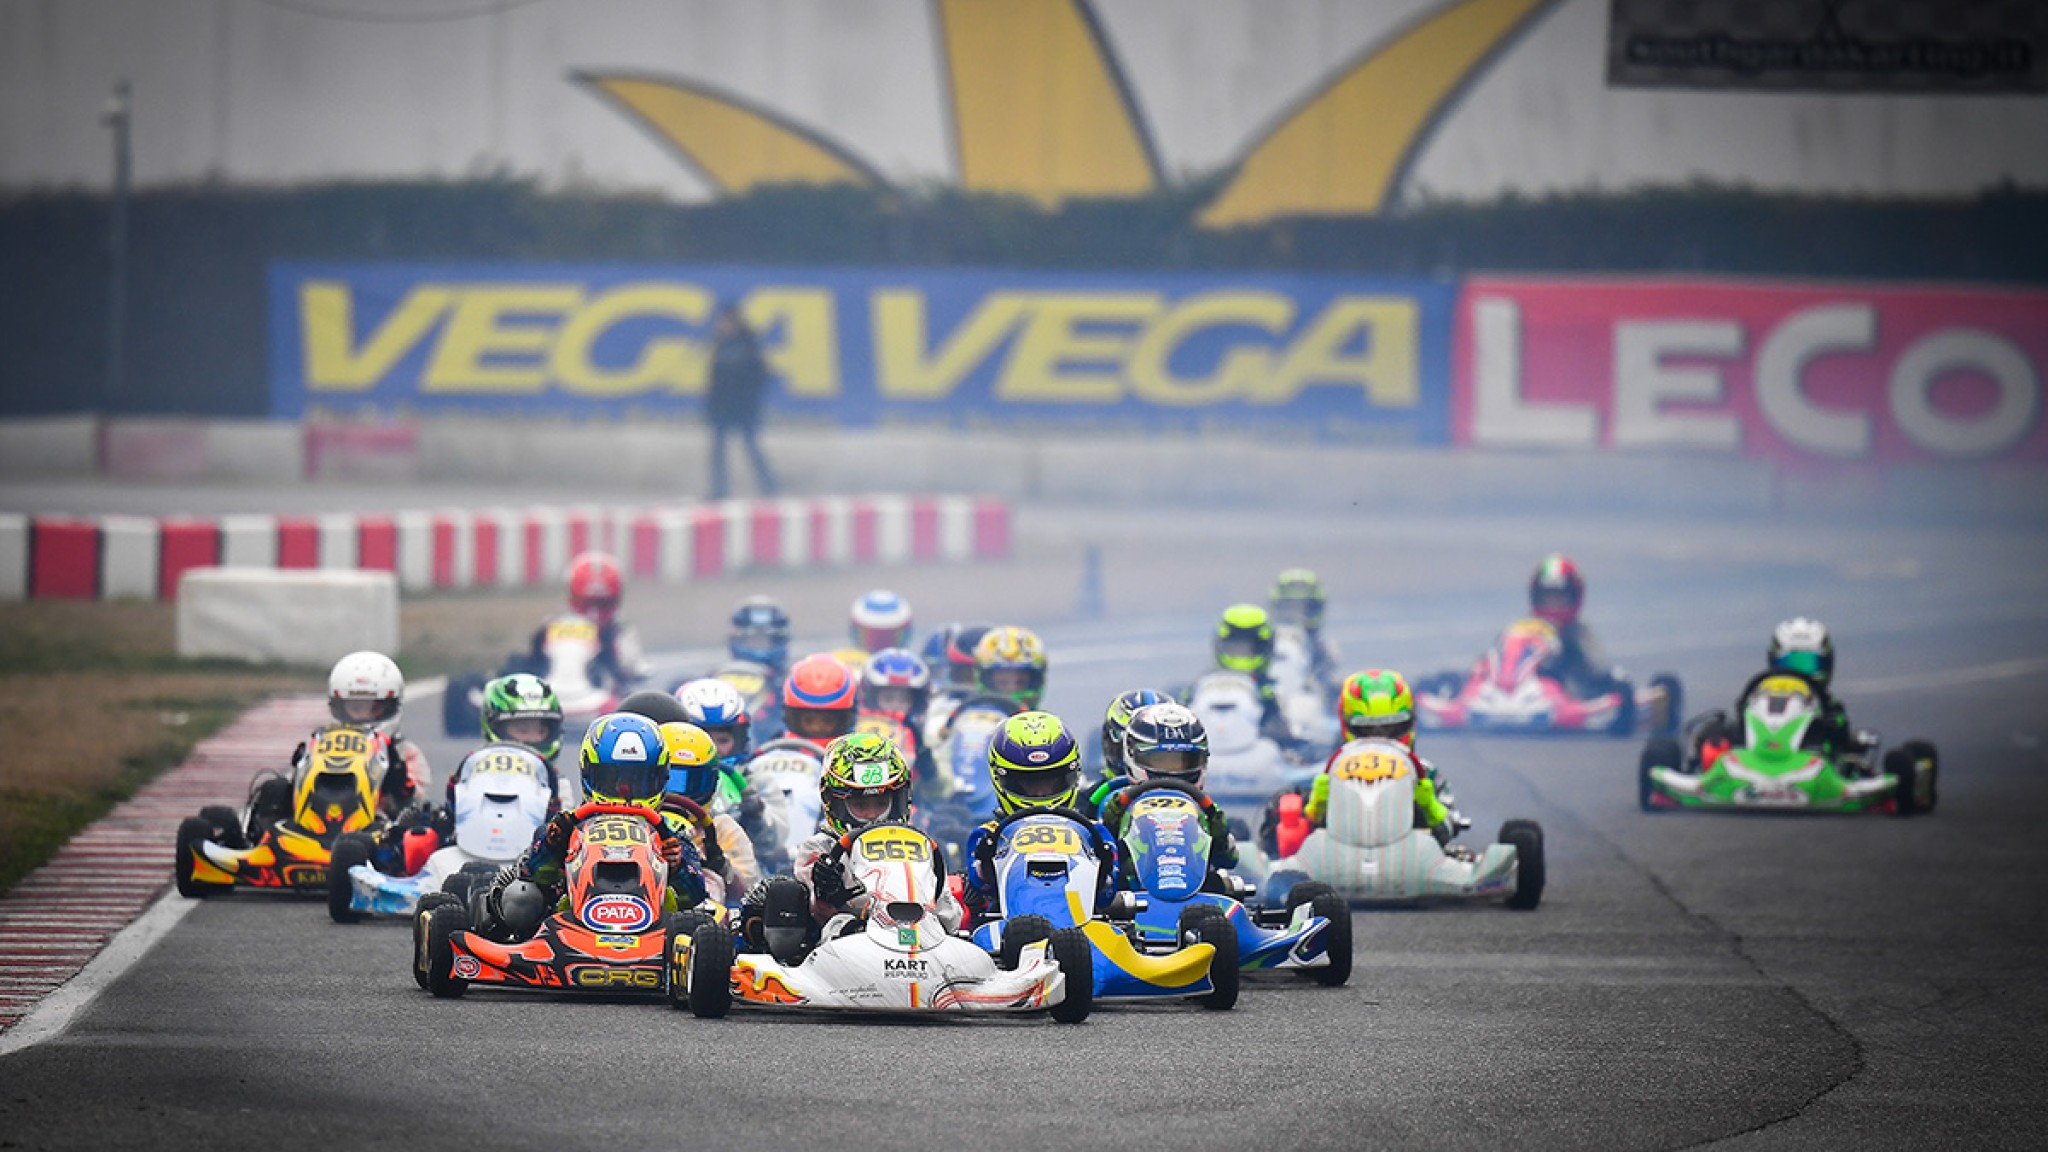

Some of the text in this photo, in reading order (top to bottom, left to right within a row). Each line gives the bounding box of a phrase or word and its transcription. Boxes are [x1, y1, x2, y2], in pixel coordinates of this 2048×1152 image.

[301, 280, 840, 396] VEGA
[870, 287, 1420, 406] VEGA
[318, 733, 367, 754] 596
[475, 755, 532, 777] 593
[1345, 754, 1397, 775] 631
[588, 822, 648, 844] 550
[1016, 826, 1073, 847] 587
[866, 840, 925, 862] 563
[596, 906, 638, 919] PATA
[884, 959, 927, 971] KART
[580, 968, 658, 987] CRG
